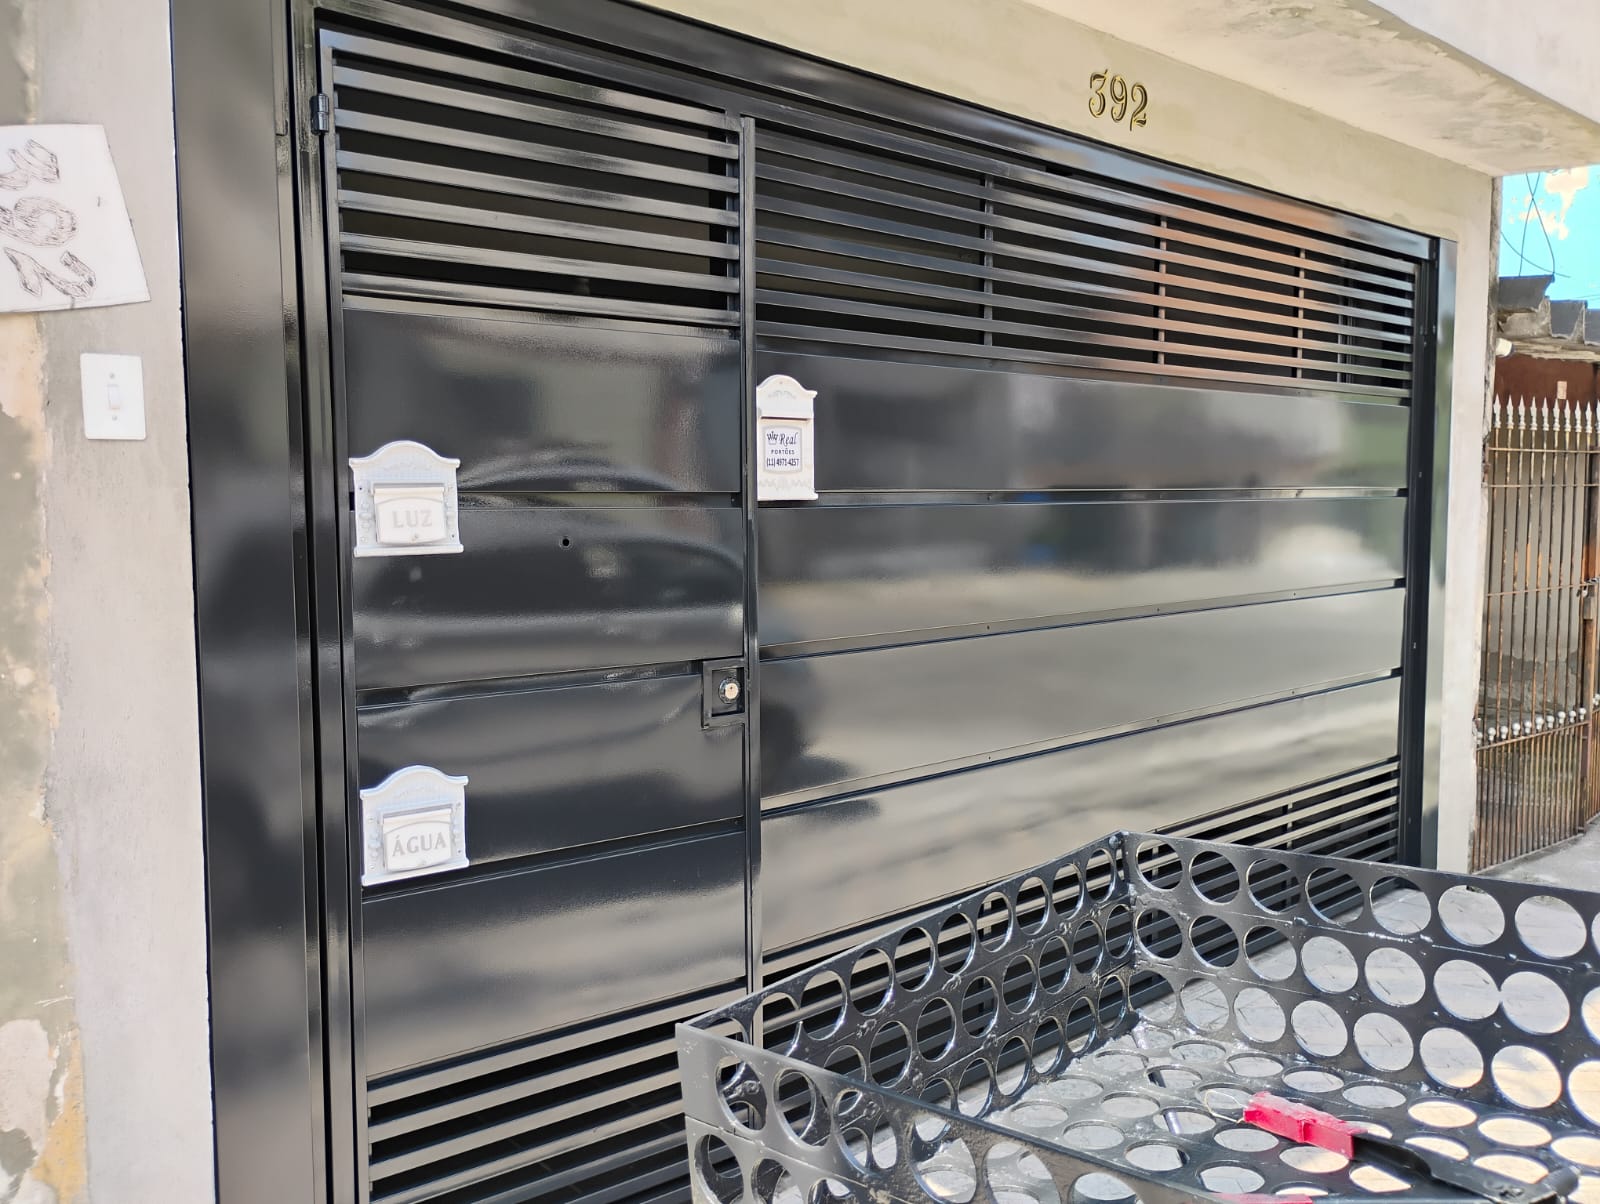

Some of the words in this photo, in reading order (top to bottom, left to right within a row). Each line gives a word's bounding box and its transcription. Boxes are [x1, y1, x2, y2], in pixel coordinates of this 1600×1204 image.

[1088, 68, 1148, 131] 392
[779, 432, 799, 447] Real
[391, 509, 433, 529] LUZ
[392, 831, 447, 857] ÁGUA
